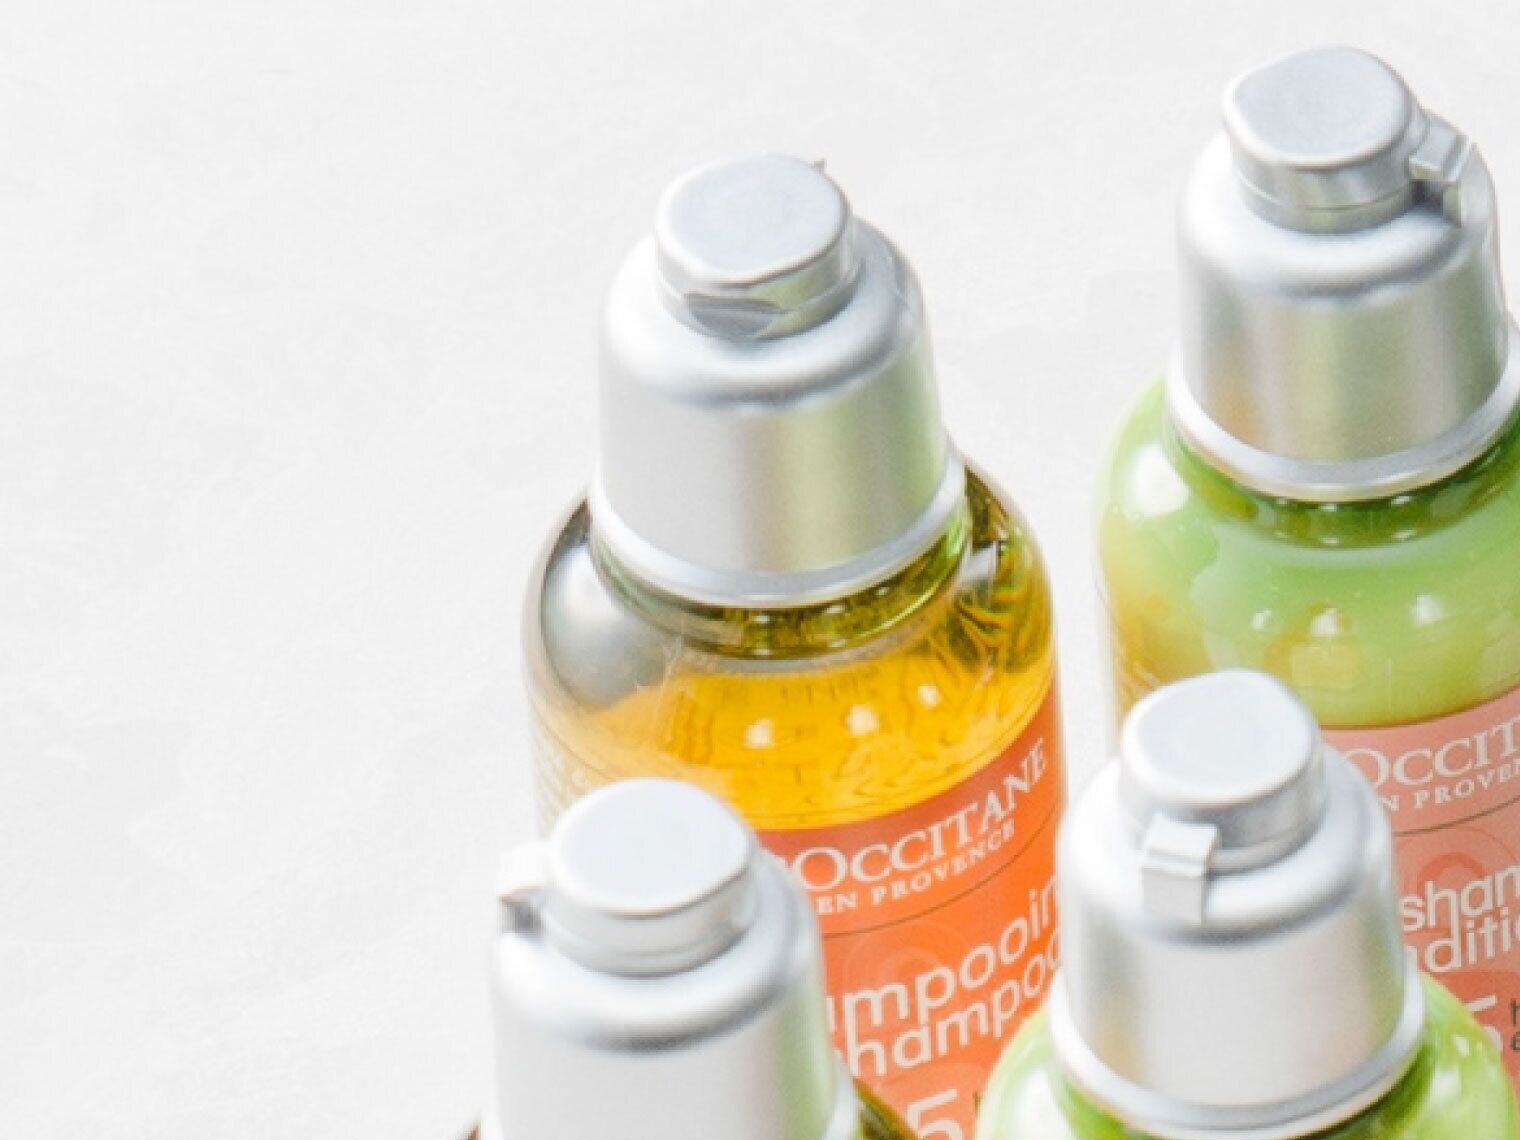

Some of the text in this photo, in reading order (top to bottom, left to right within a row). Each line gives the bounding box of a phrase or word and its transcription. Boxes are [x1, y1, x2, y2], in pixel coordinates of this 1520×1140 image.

[790, 736, 1047, 890] OCCITANE
[815, 820, 1015, 916] EN PROVENCE
[836, 929, 1060, 1077] hampoo
